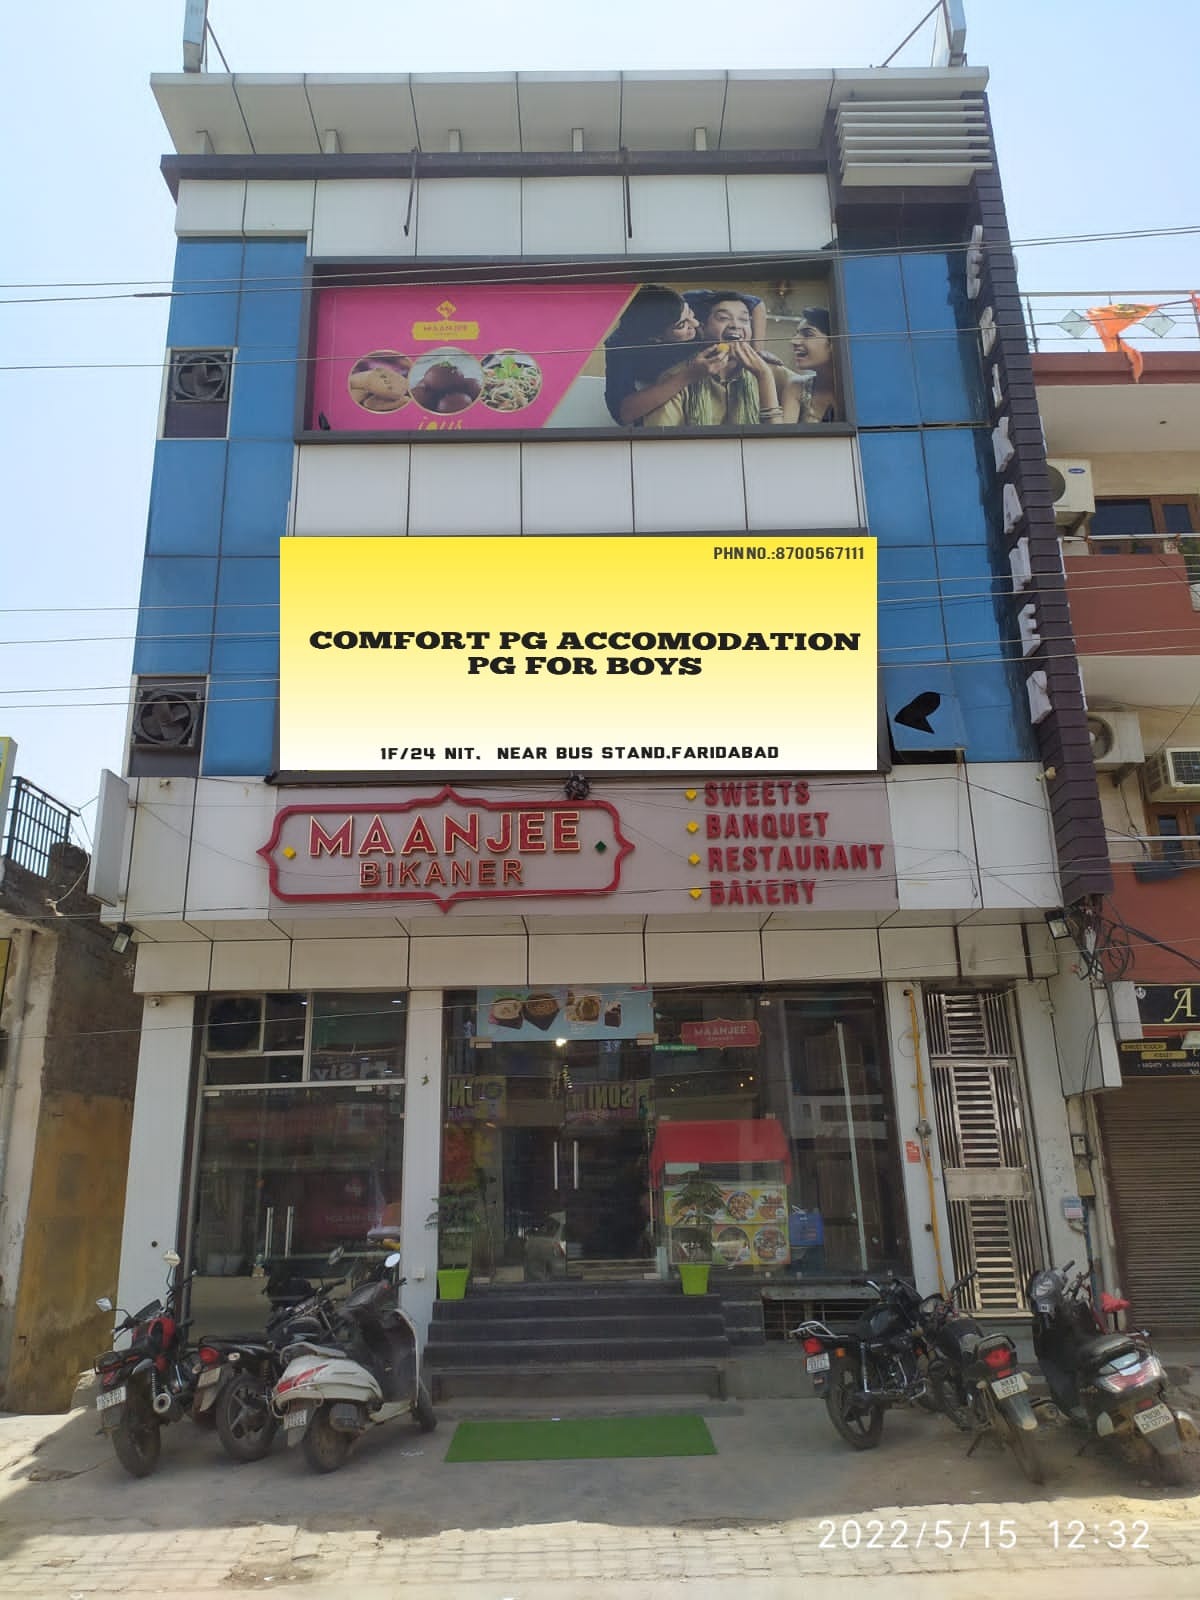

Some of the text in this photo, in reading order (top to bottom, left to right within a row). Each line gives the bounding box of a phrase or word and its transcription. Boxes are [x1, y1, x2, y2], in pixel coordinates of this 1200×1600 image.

[309, 631, 861, 651] COMFORT PG ACCOMODATION
[467, 656, 702, 676] PG FOR BOYS
[380, 747, 436, 761] 1F/24
[497, 747, 547, 760] NEAR
[556, 747, 593, 760] BUS
[705, 780, 811, 808] SWEETS
[308, 810, 581, 857] MAANJEE
[706, 811, 830, 840] BANQUET
[708, 844, 886, 872] RESTAURANT
[358, 858, 525, 889] BIKANER
[709, 878, 817, 907] BAKERY
